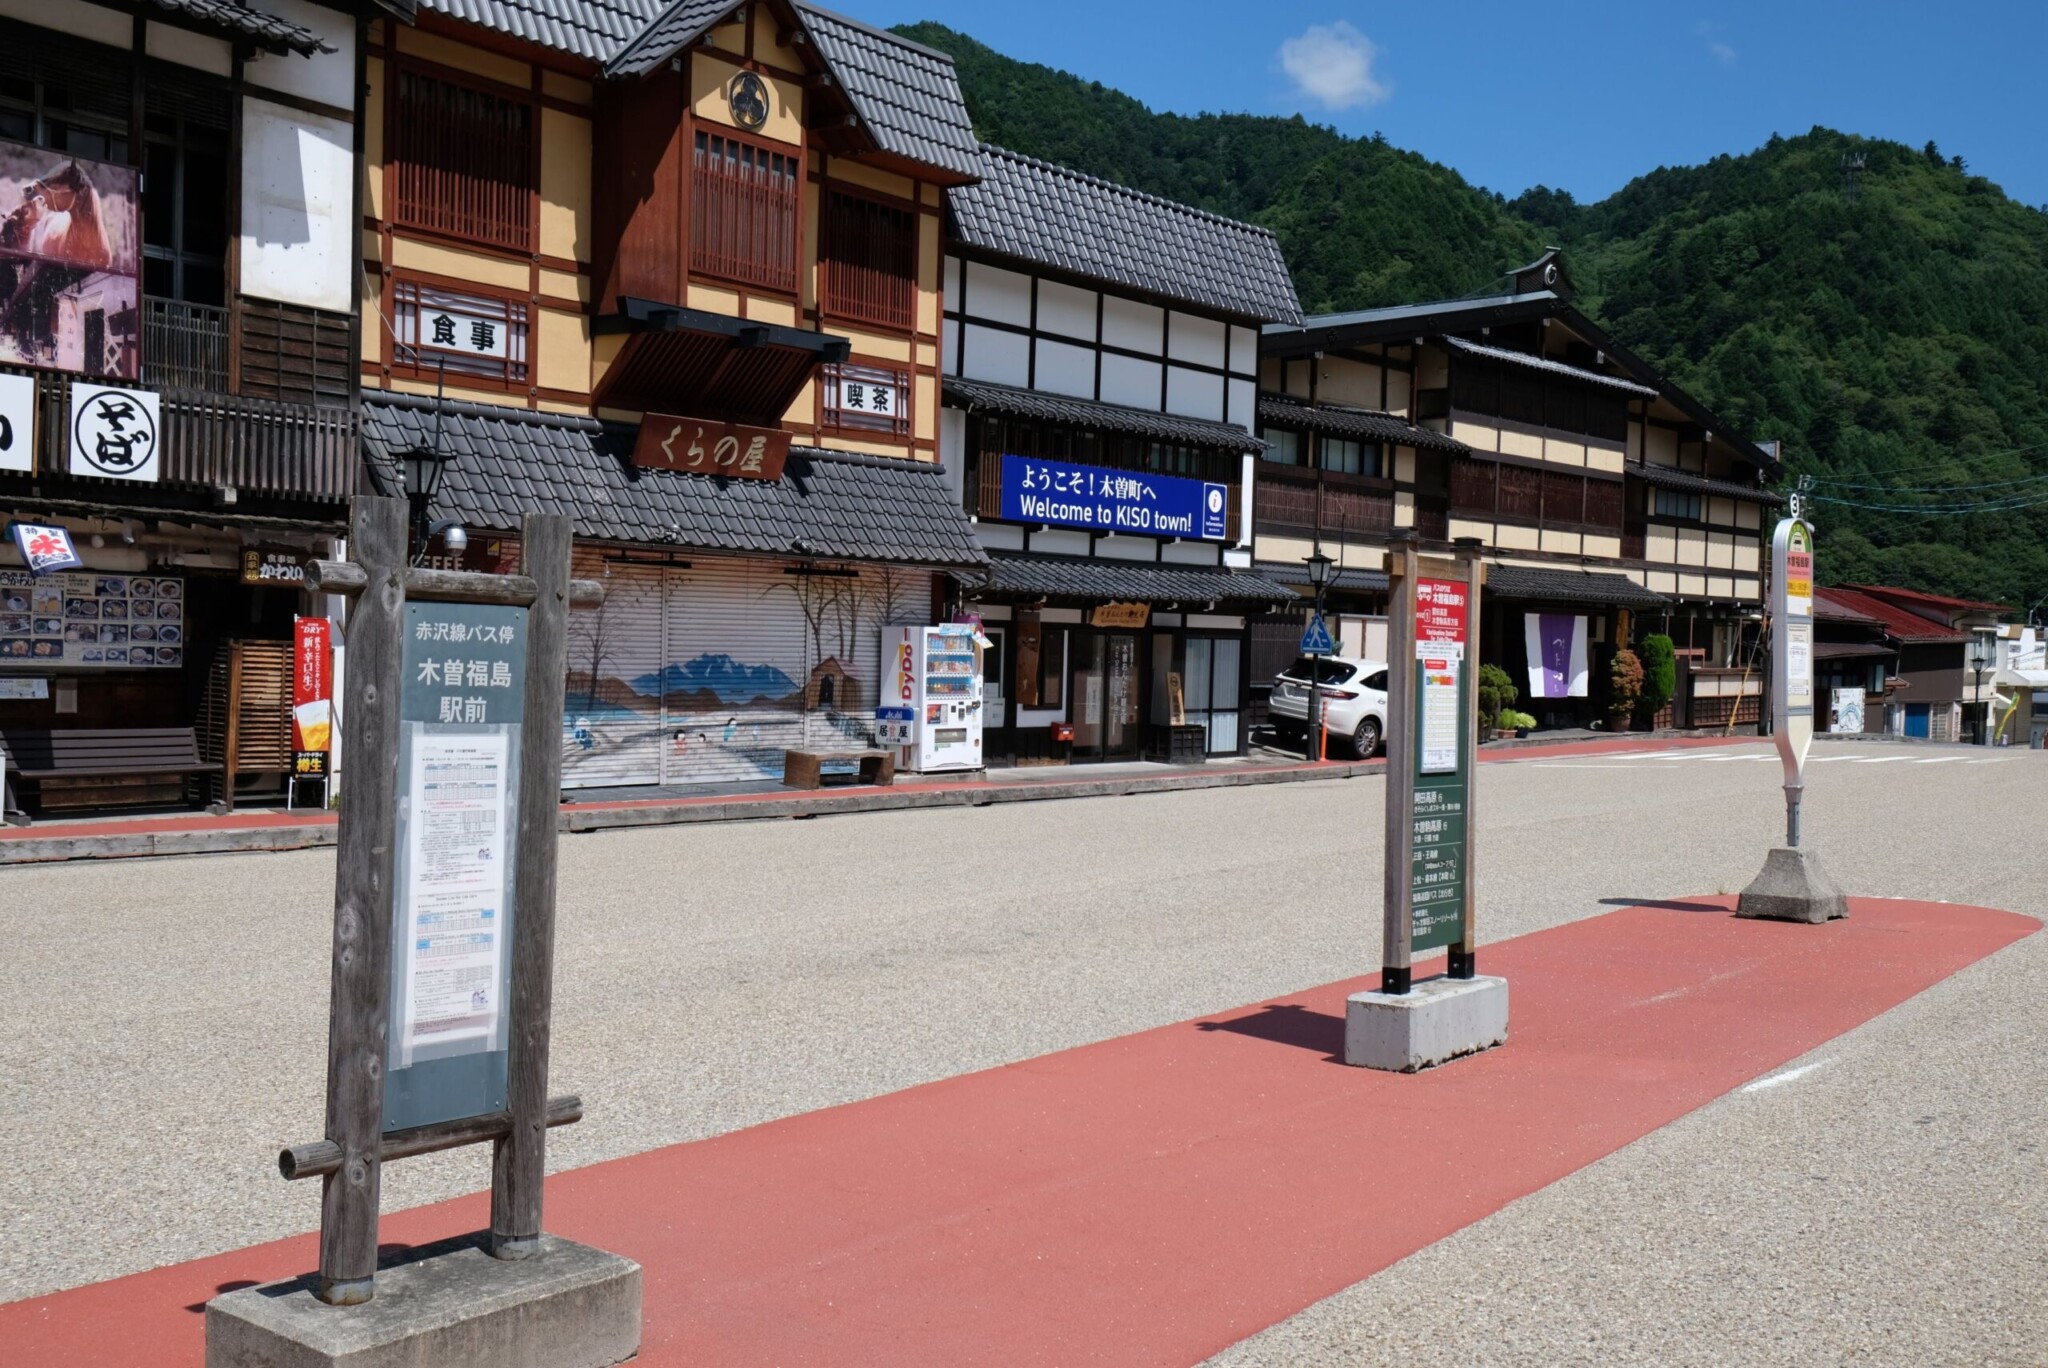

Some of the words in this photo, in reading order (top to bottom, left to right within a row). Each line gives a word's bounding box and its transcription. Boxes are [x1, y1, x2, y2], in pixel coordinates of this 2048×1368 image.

[430, 313, 496, 352] 食事
[846, 383, 890, 413] 喫茶
[96, 398, 150, 467] そば
[659, 423, 768, 474] くらの屋
[1020, 494, 1092, 523] Welcome
[1097, 503, 1112, 524] to
[1116, 507, 1150, 528] KISO
[1155, 511, 1192, 533] town!
[30, 534, 67, 556] 氷
[259, 563, 304, 580] かわい
[415, 620, 515, 645] 赤沢線バス停
[416, 657, 513, 688] 木曽福島
[902, 644, 915, 700] DyDo
[438, 695, 488, 724] 駅前
[885, 710, 903, 719] Asahi
[296, 758, 323, 773] 樽生
